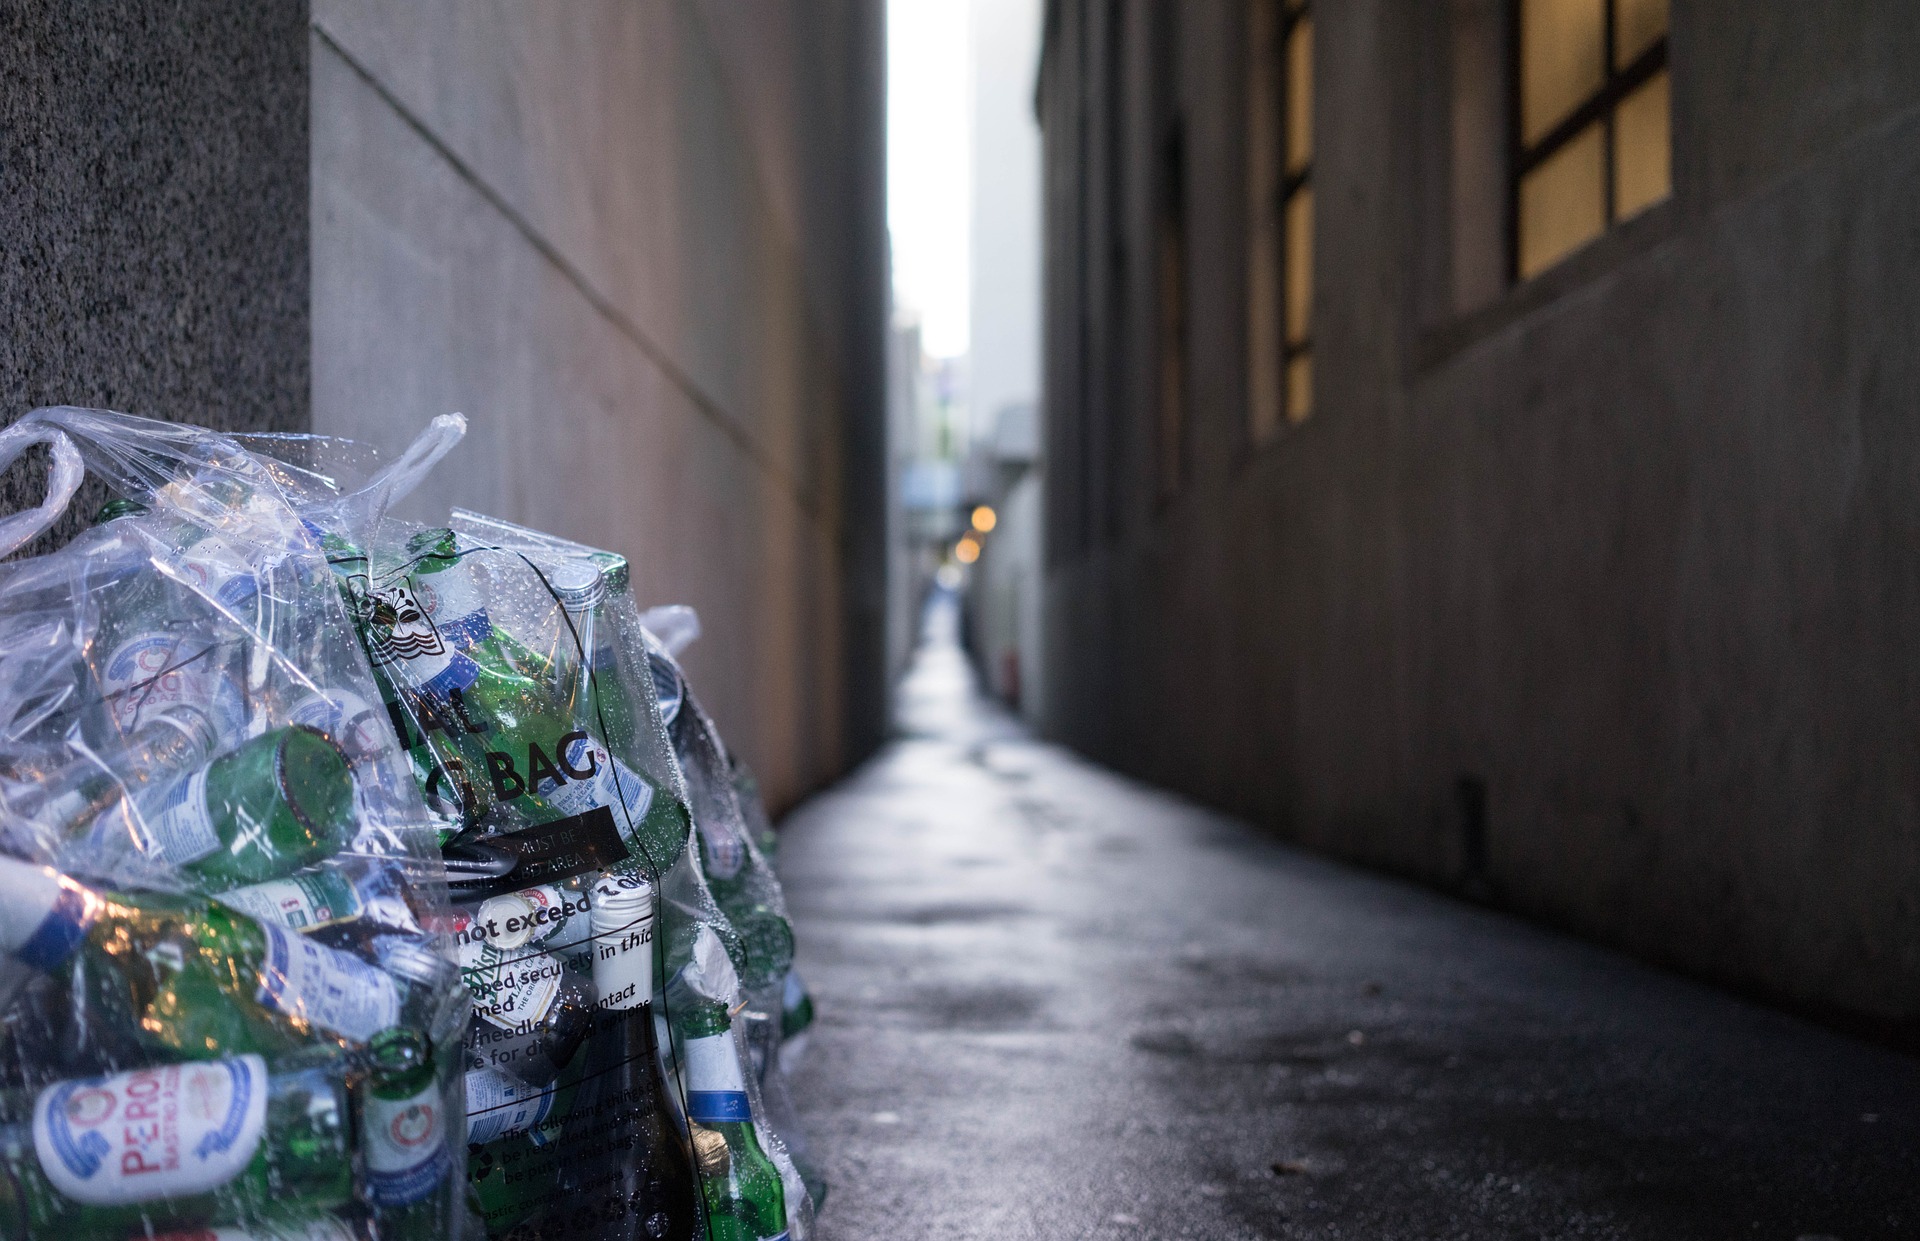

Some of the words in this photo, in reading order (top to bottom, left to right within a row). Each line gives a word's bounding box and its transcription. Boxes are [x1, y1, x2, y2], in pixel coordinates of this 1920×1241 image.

[485, 730, 596, 801] BAG
[455, 918, 500, 946] not
[506, 892, 592, 933] exceed
[521, 951, 594, 985] securely
[599, 945, 617, 961] in
[490, 1048, 519, 1066] for
[501, 1126, 529, 1143] The
[535, 1102, 603, 1134] following
[502, 1150, 521, 1165] be
[527, 1129, 588, 1157] recycled
[504, 1170, 523, 1185] be
[529, 1161, 554, 1181] put
[484, 1204, 516, 1221] astic
